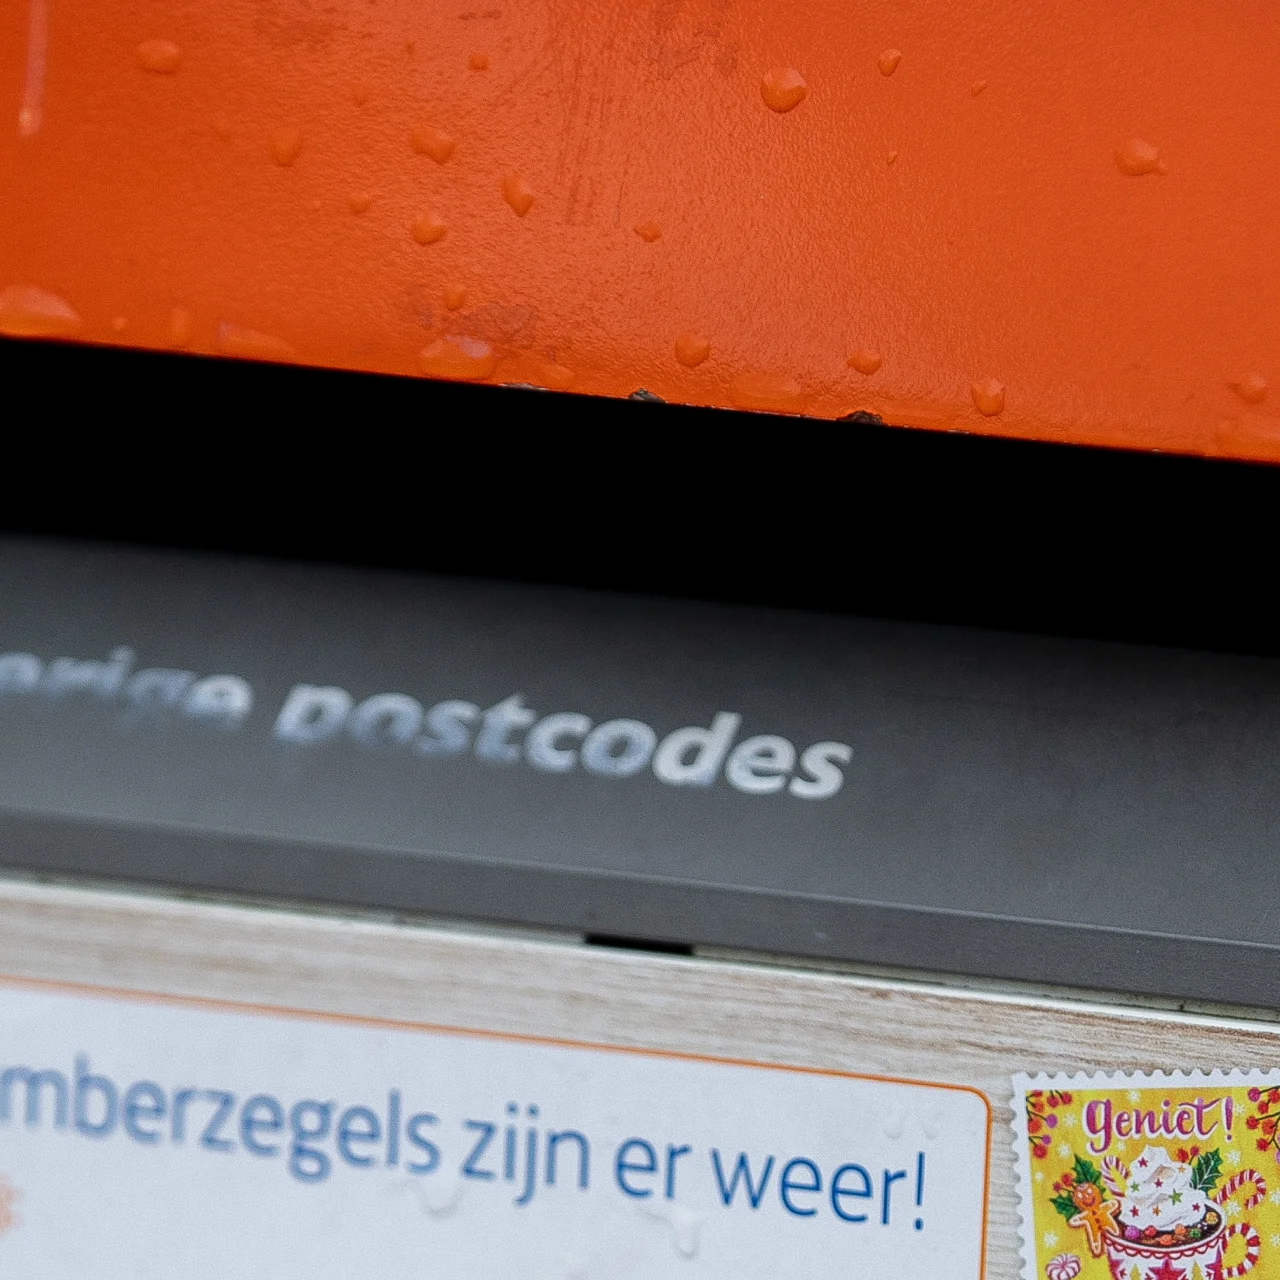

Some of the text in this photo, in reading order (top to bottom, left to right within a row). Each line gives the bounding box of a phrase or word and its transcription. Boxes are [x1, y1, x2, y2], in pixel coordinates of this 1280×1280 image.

[273, 680, 854, 800] postcodes
[459, 1101, 591, 1208] zijn
[612, 1134, 693, 1201] er
[710, 1149, 927, 1232] weer!
